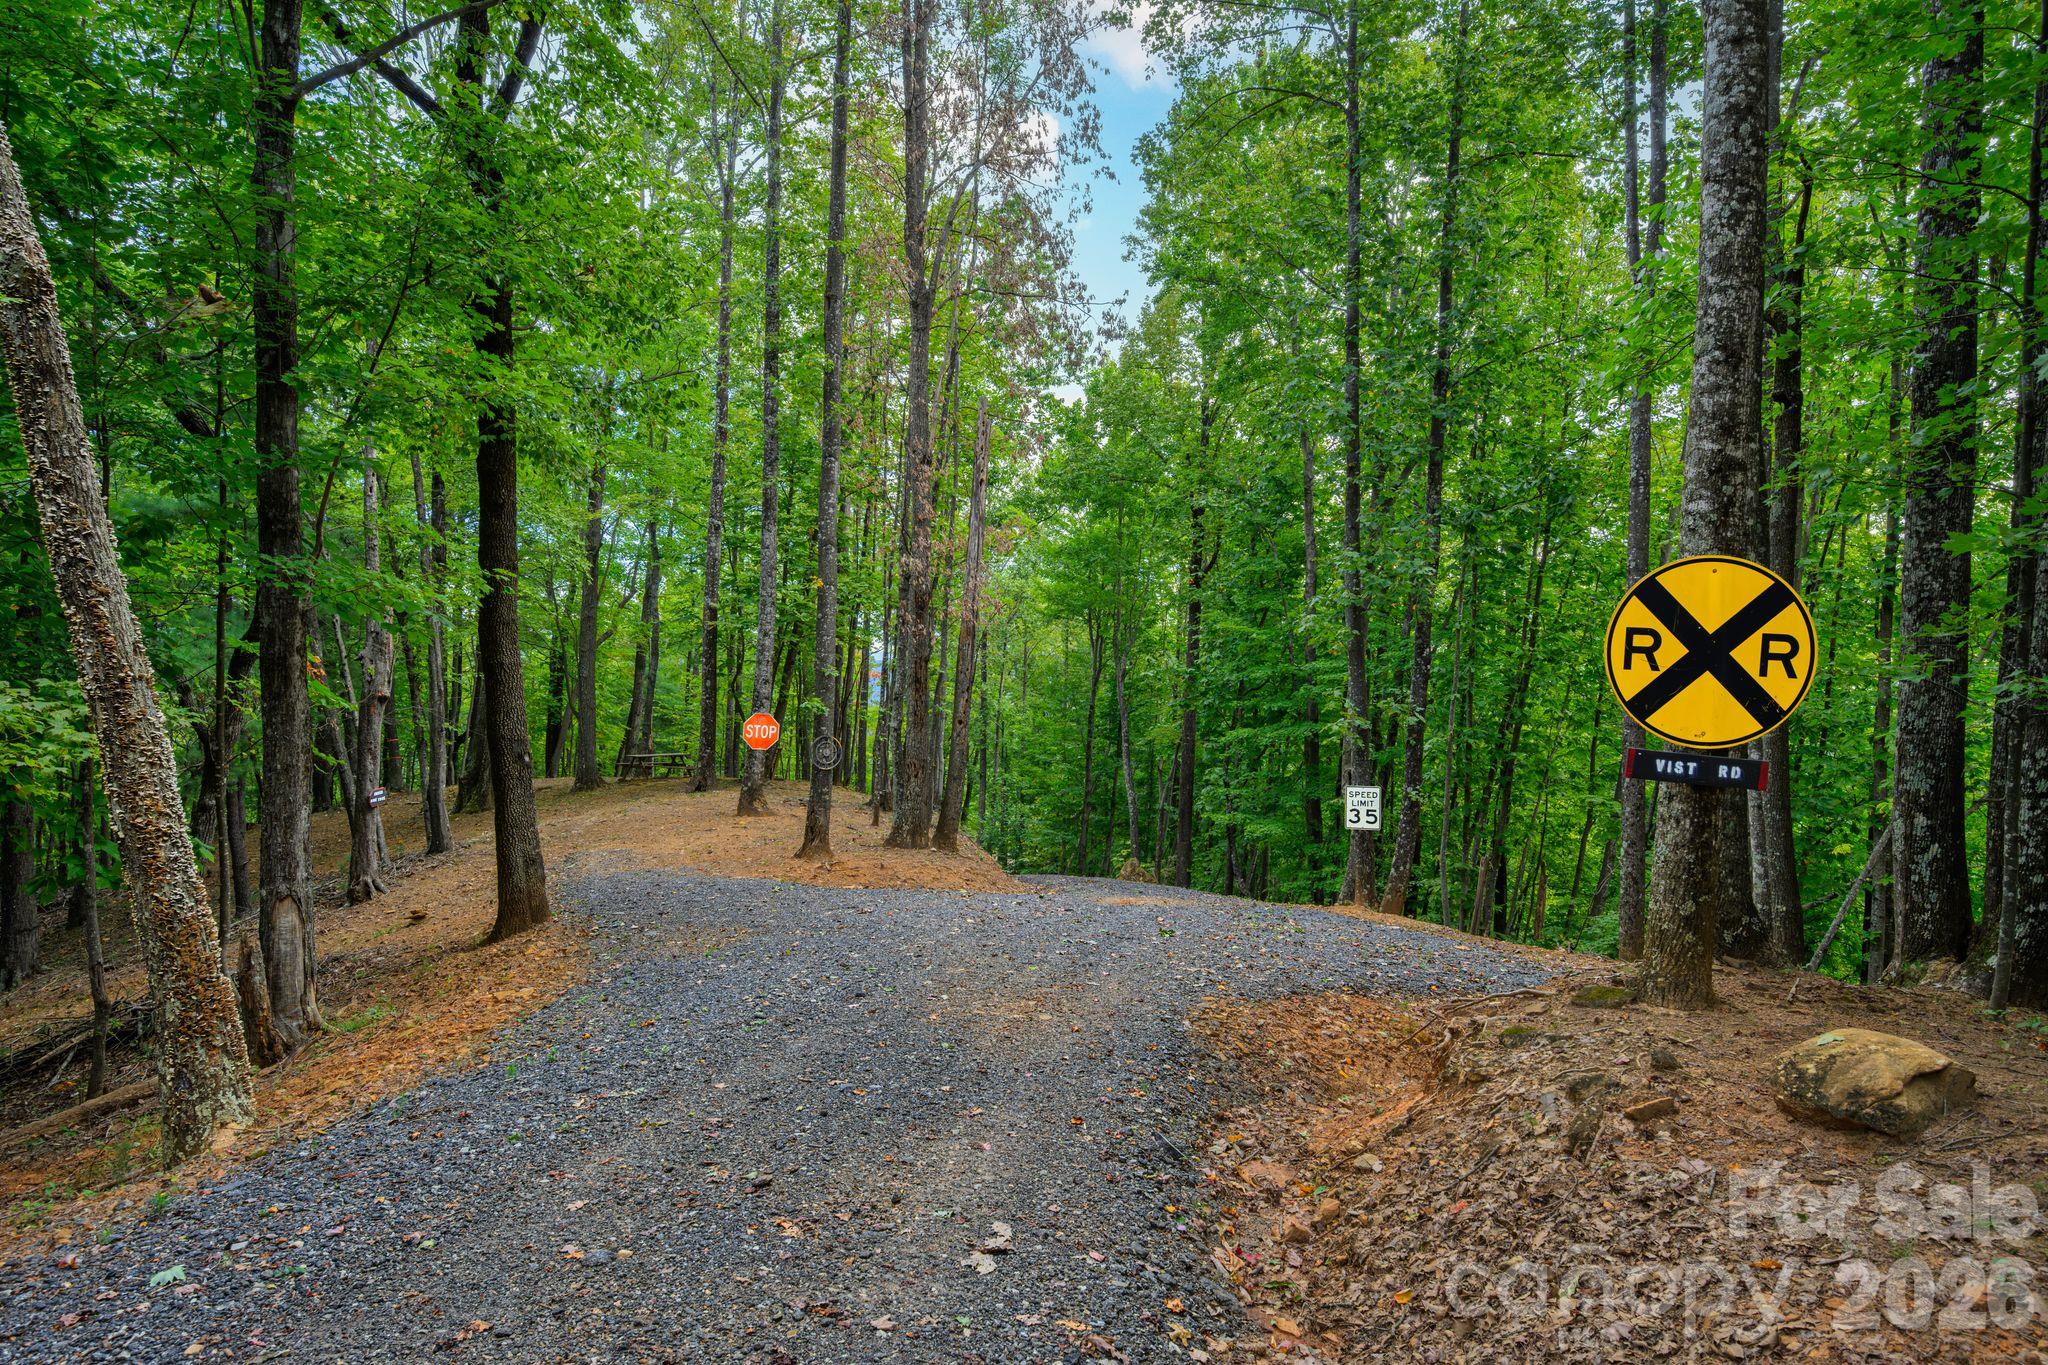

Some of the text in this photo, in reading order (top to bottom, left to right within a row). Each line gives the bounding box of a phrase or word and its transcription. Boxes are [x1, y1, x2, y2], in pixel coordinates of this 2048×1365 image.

[1623, 627, 1800, 679] R R
[745, 724, 777, 739] STOP
[1655, 758, 1742, 779] VIST RD
[1348, 808, 1378, 824] 35
